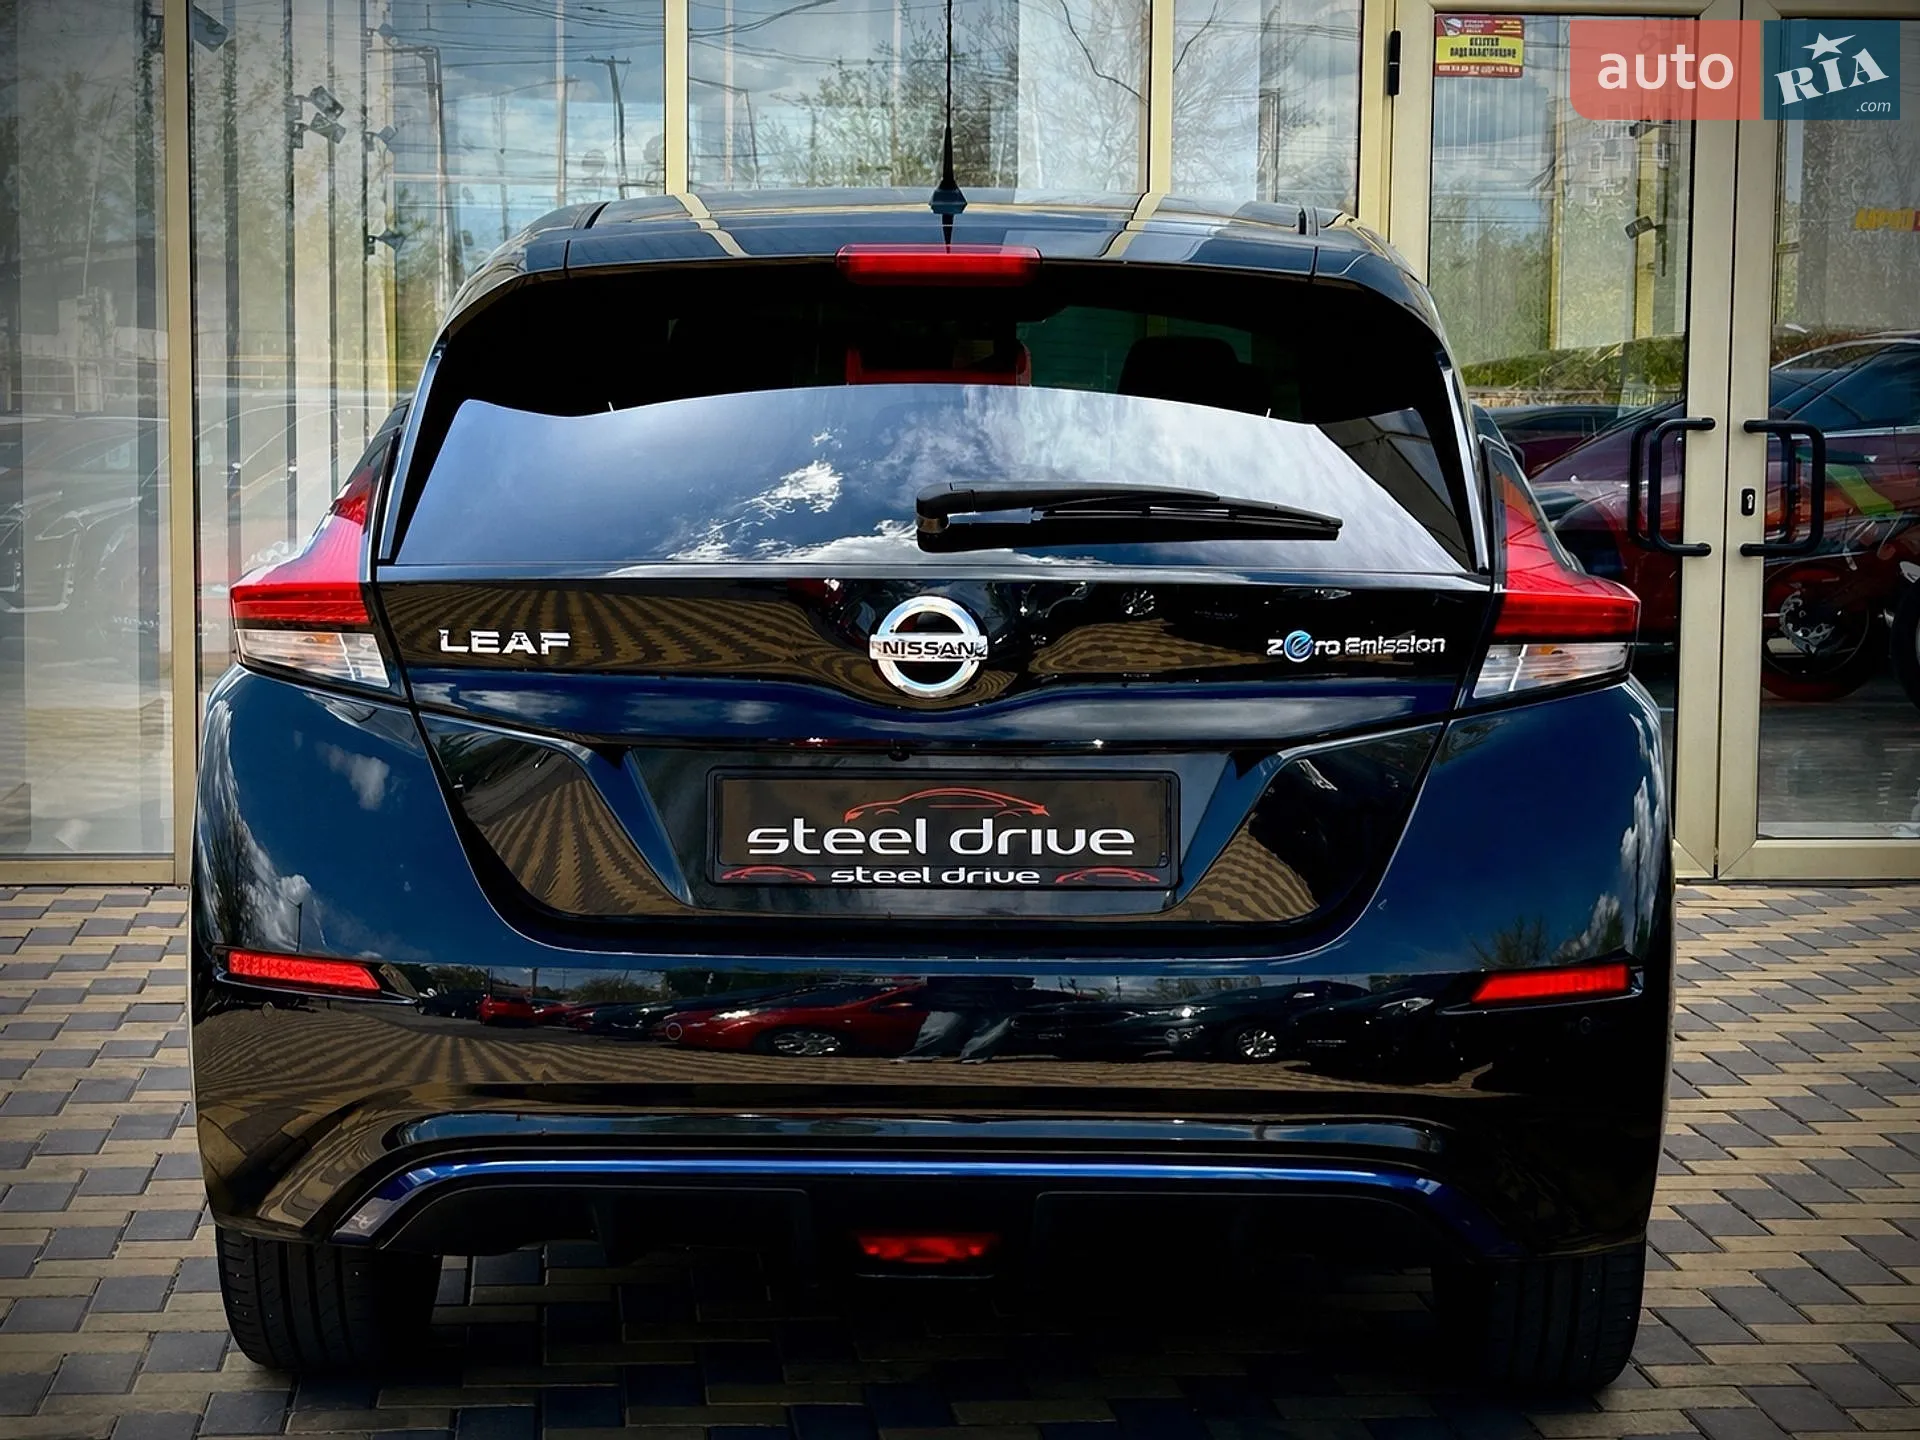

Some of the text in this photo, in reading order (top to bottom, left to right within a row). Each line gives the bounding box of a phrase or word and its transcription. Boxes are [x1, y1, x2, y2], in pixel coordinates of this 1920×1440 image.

[438, 629, 571, 656] LEAF
[882, 640, 975, 656] NISSAN
[1266, 630, 1446, 663] zero Emission
[747, 817, 1136, 856] steel drive
[830, 865, 1041, 885] steel drive
